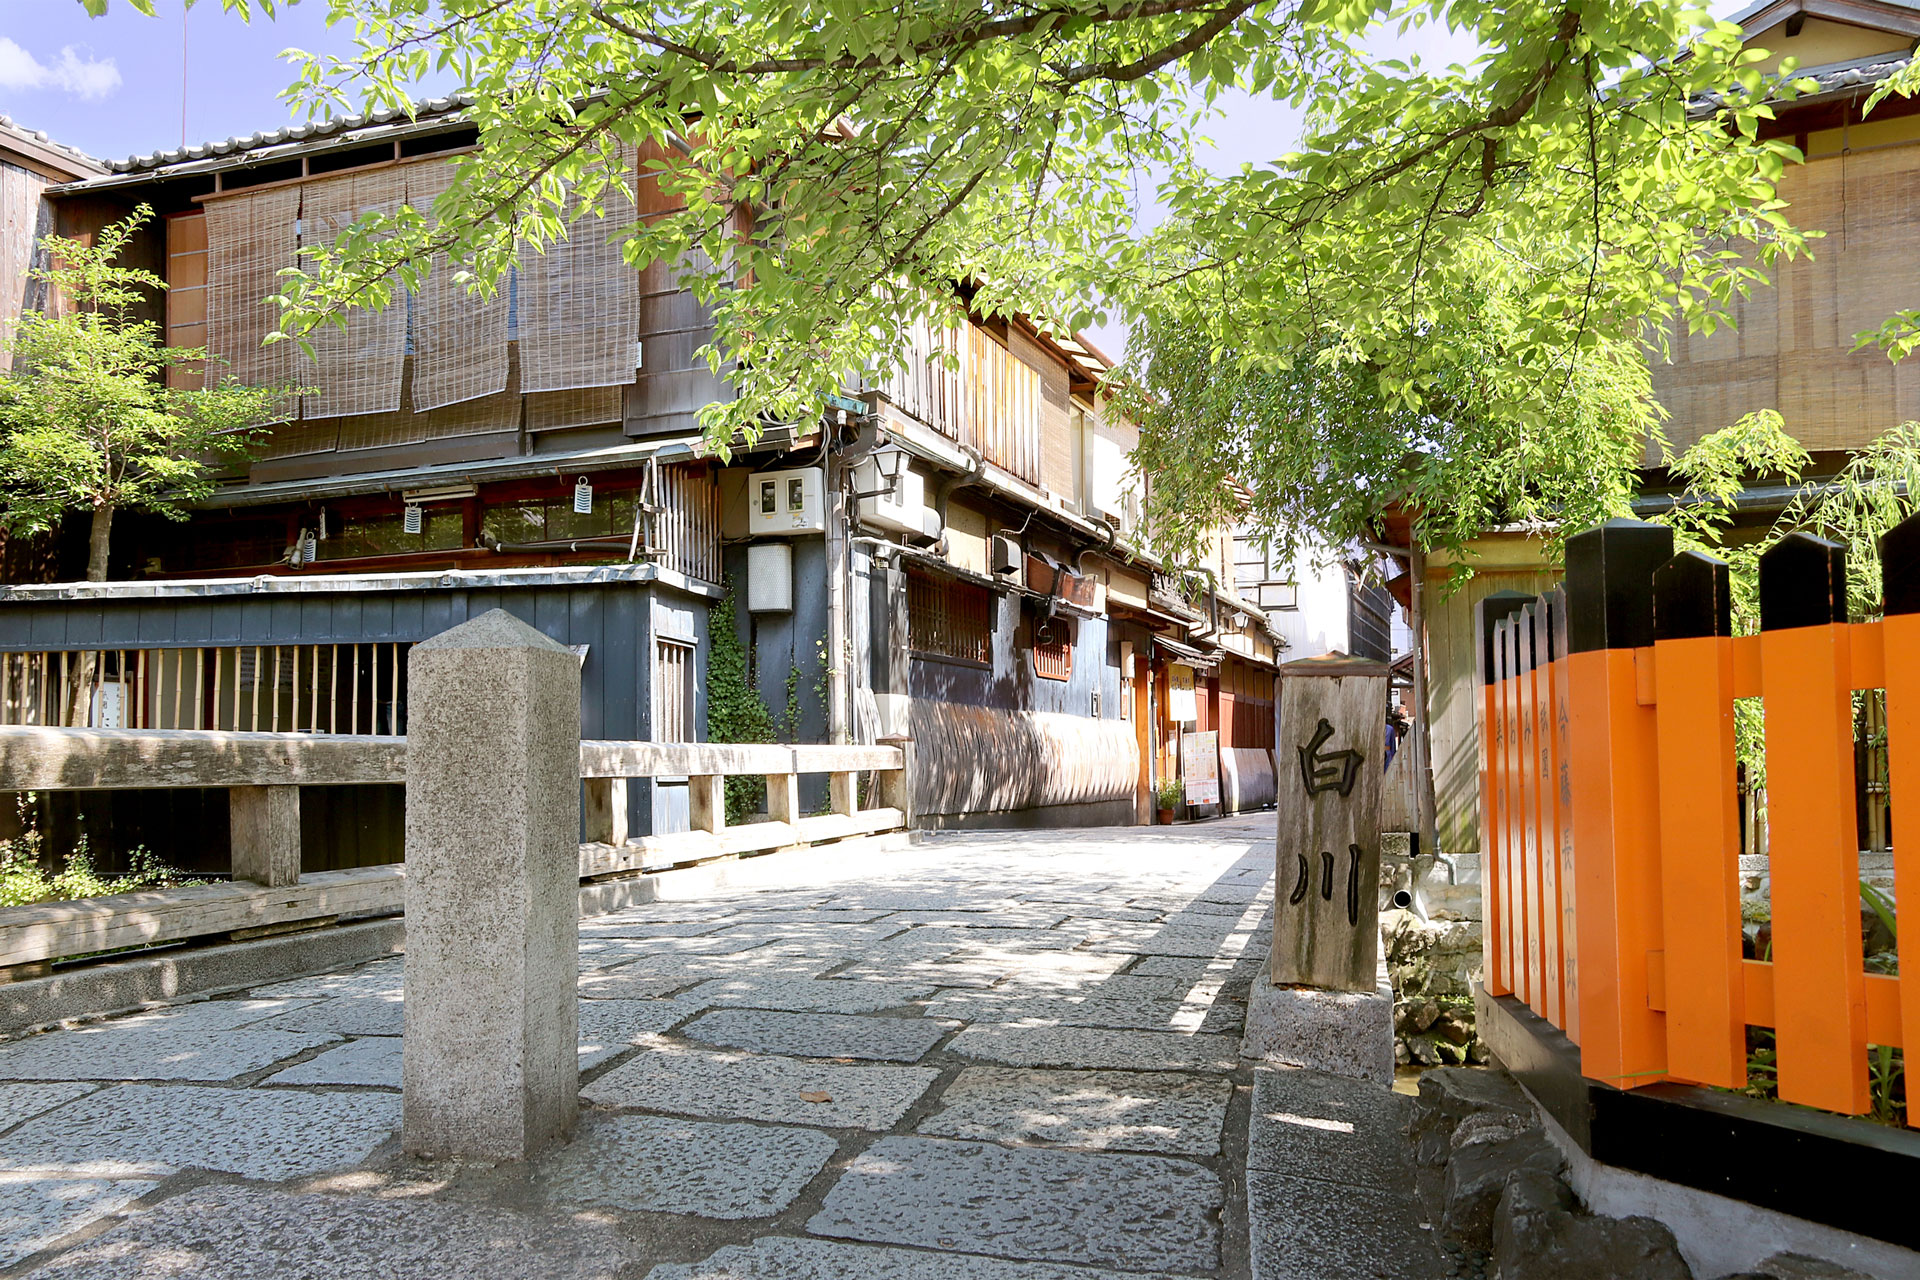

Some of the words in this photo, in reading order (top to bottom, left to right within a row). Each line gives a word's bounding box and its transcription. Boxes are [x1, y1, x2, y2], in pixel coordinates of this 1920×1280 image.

[1290, 718, 1364, 927] 白川
[1558, 696, 1578, 1000] 今藤長十郎
